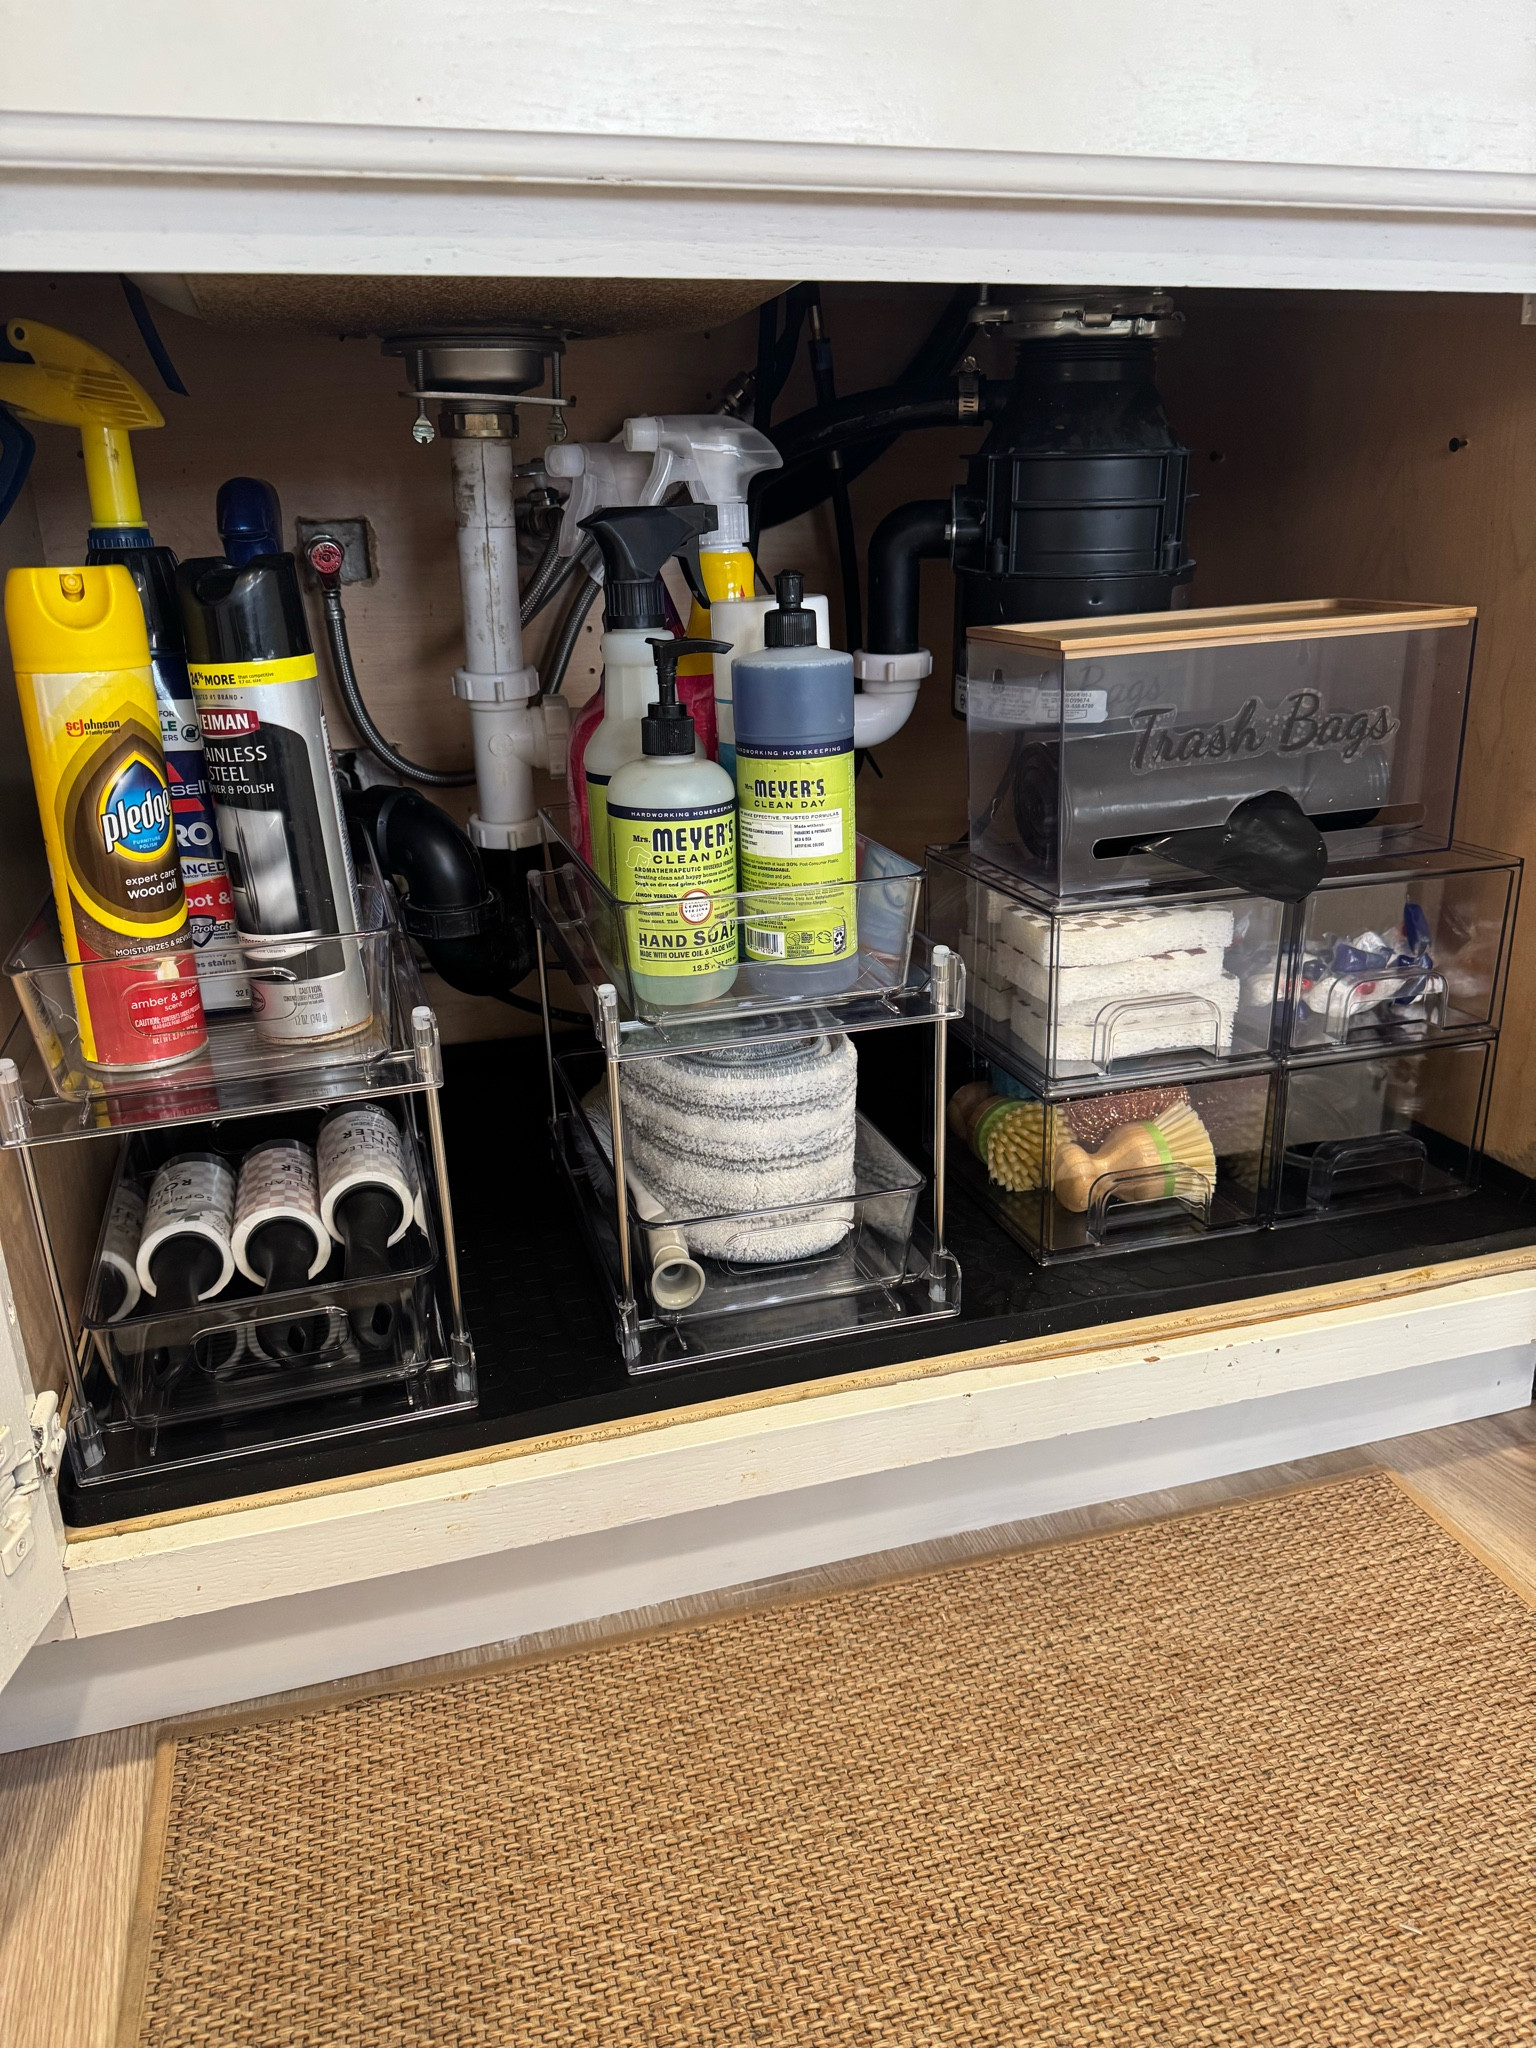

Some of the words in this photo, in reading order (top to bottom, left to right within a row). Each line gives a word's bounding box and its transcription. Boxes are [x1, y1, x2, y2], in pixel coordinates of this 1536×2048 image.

[204, 673, 236, 686] MORE
[160, 720, 177, 732] LE
[201, 713, 249, 731] EIMAN
[1132, 698, 1266, 769] Trash
[1277, 692, 1396, 759] Bags
[163, 734, 179, 742] ERS
[204, 745, 268, 763] AINLESS
[782, 745, 841, 756] HOMEKEEPING
[208, 766, 249, 782] STEEL
[228, 785, 234, 795] &
[236, 783, 275, 794] POLISH
[754, 800, 793, 809] CLEAN
[800, 799, 826, 809] DAY
[101, 788, 171, 854] pledge
[177, 821, 213, 847] RO
[632, 834, 651, 843] Mrs.
[139, 842, 158, 850] POLISH
[652, 852, 710, 865] CLEAN
[715, 845, 734, 860] DAY
[634, 866, 702, 874] AROMATHERAPEUTIC
[125, 872, 158, 886] expert
[634, 873, 657, 881] Creating
[127, 882, 164, 900] wood
[166, 878, 177, 892] oil
[634, 880, 649, 888] Tough
[218, 891, 231, 905] &
[192, 922, 230, 933] Protect
[639, 932, 688, 948] HAND
[115, 943, 169, 957] MOISTURIZES
[668, 950, 690, 959] OLIVE
[691, 949, 703, 958] OIL
[704, 948, 709, 956] &
[207, 959, 236, 968] stains
[692, 962, 709, 972] 12.5
[131, 996, 168, 1010] amber
[170, 992, 178, 1002] &
[180, 984, 199, 999] argan
[235, 989, 244, 998] 32
[164, 1001, 182, 1011] scent
[343, 1128, 399, 1147] OLLER
[281, 1164, 312, 1180] LER
